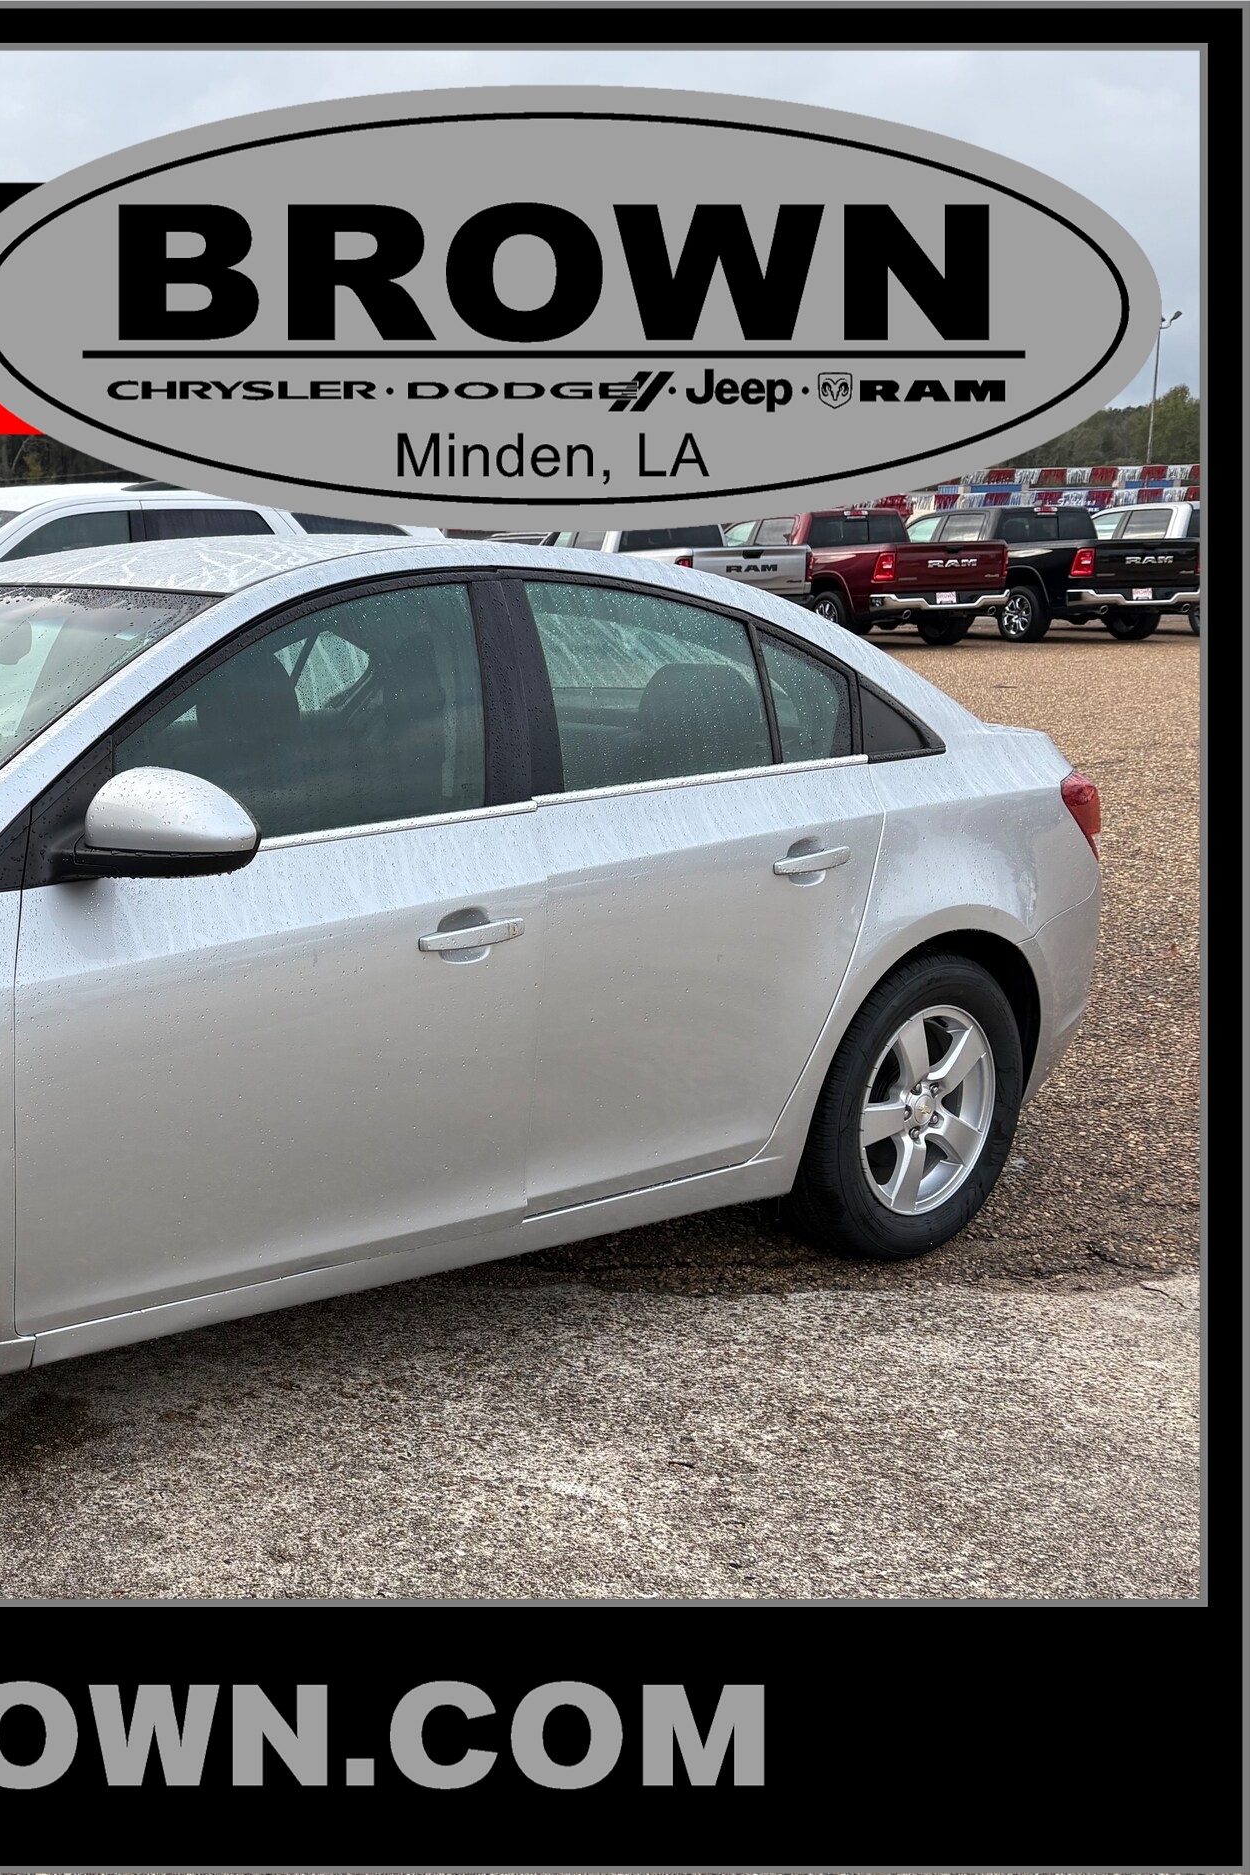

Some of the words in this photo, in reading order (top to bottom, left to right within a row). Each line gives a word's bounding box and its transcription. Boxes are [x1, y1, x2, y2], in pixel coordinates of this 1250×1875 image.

[927, 558, 978, 569] RAM
[1125, 555, 1174, 565] RAM
[725, 563, 778, 573] RAM
